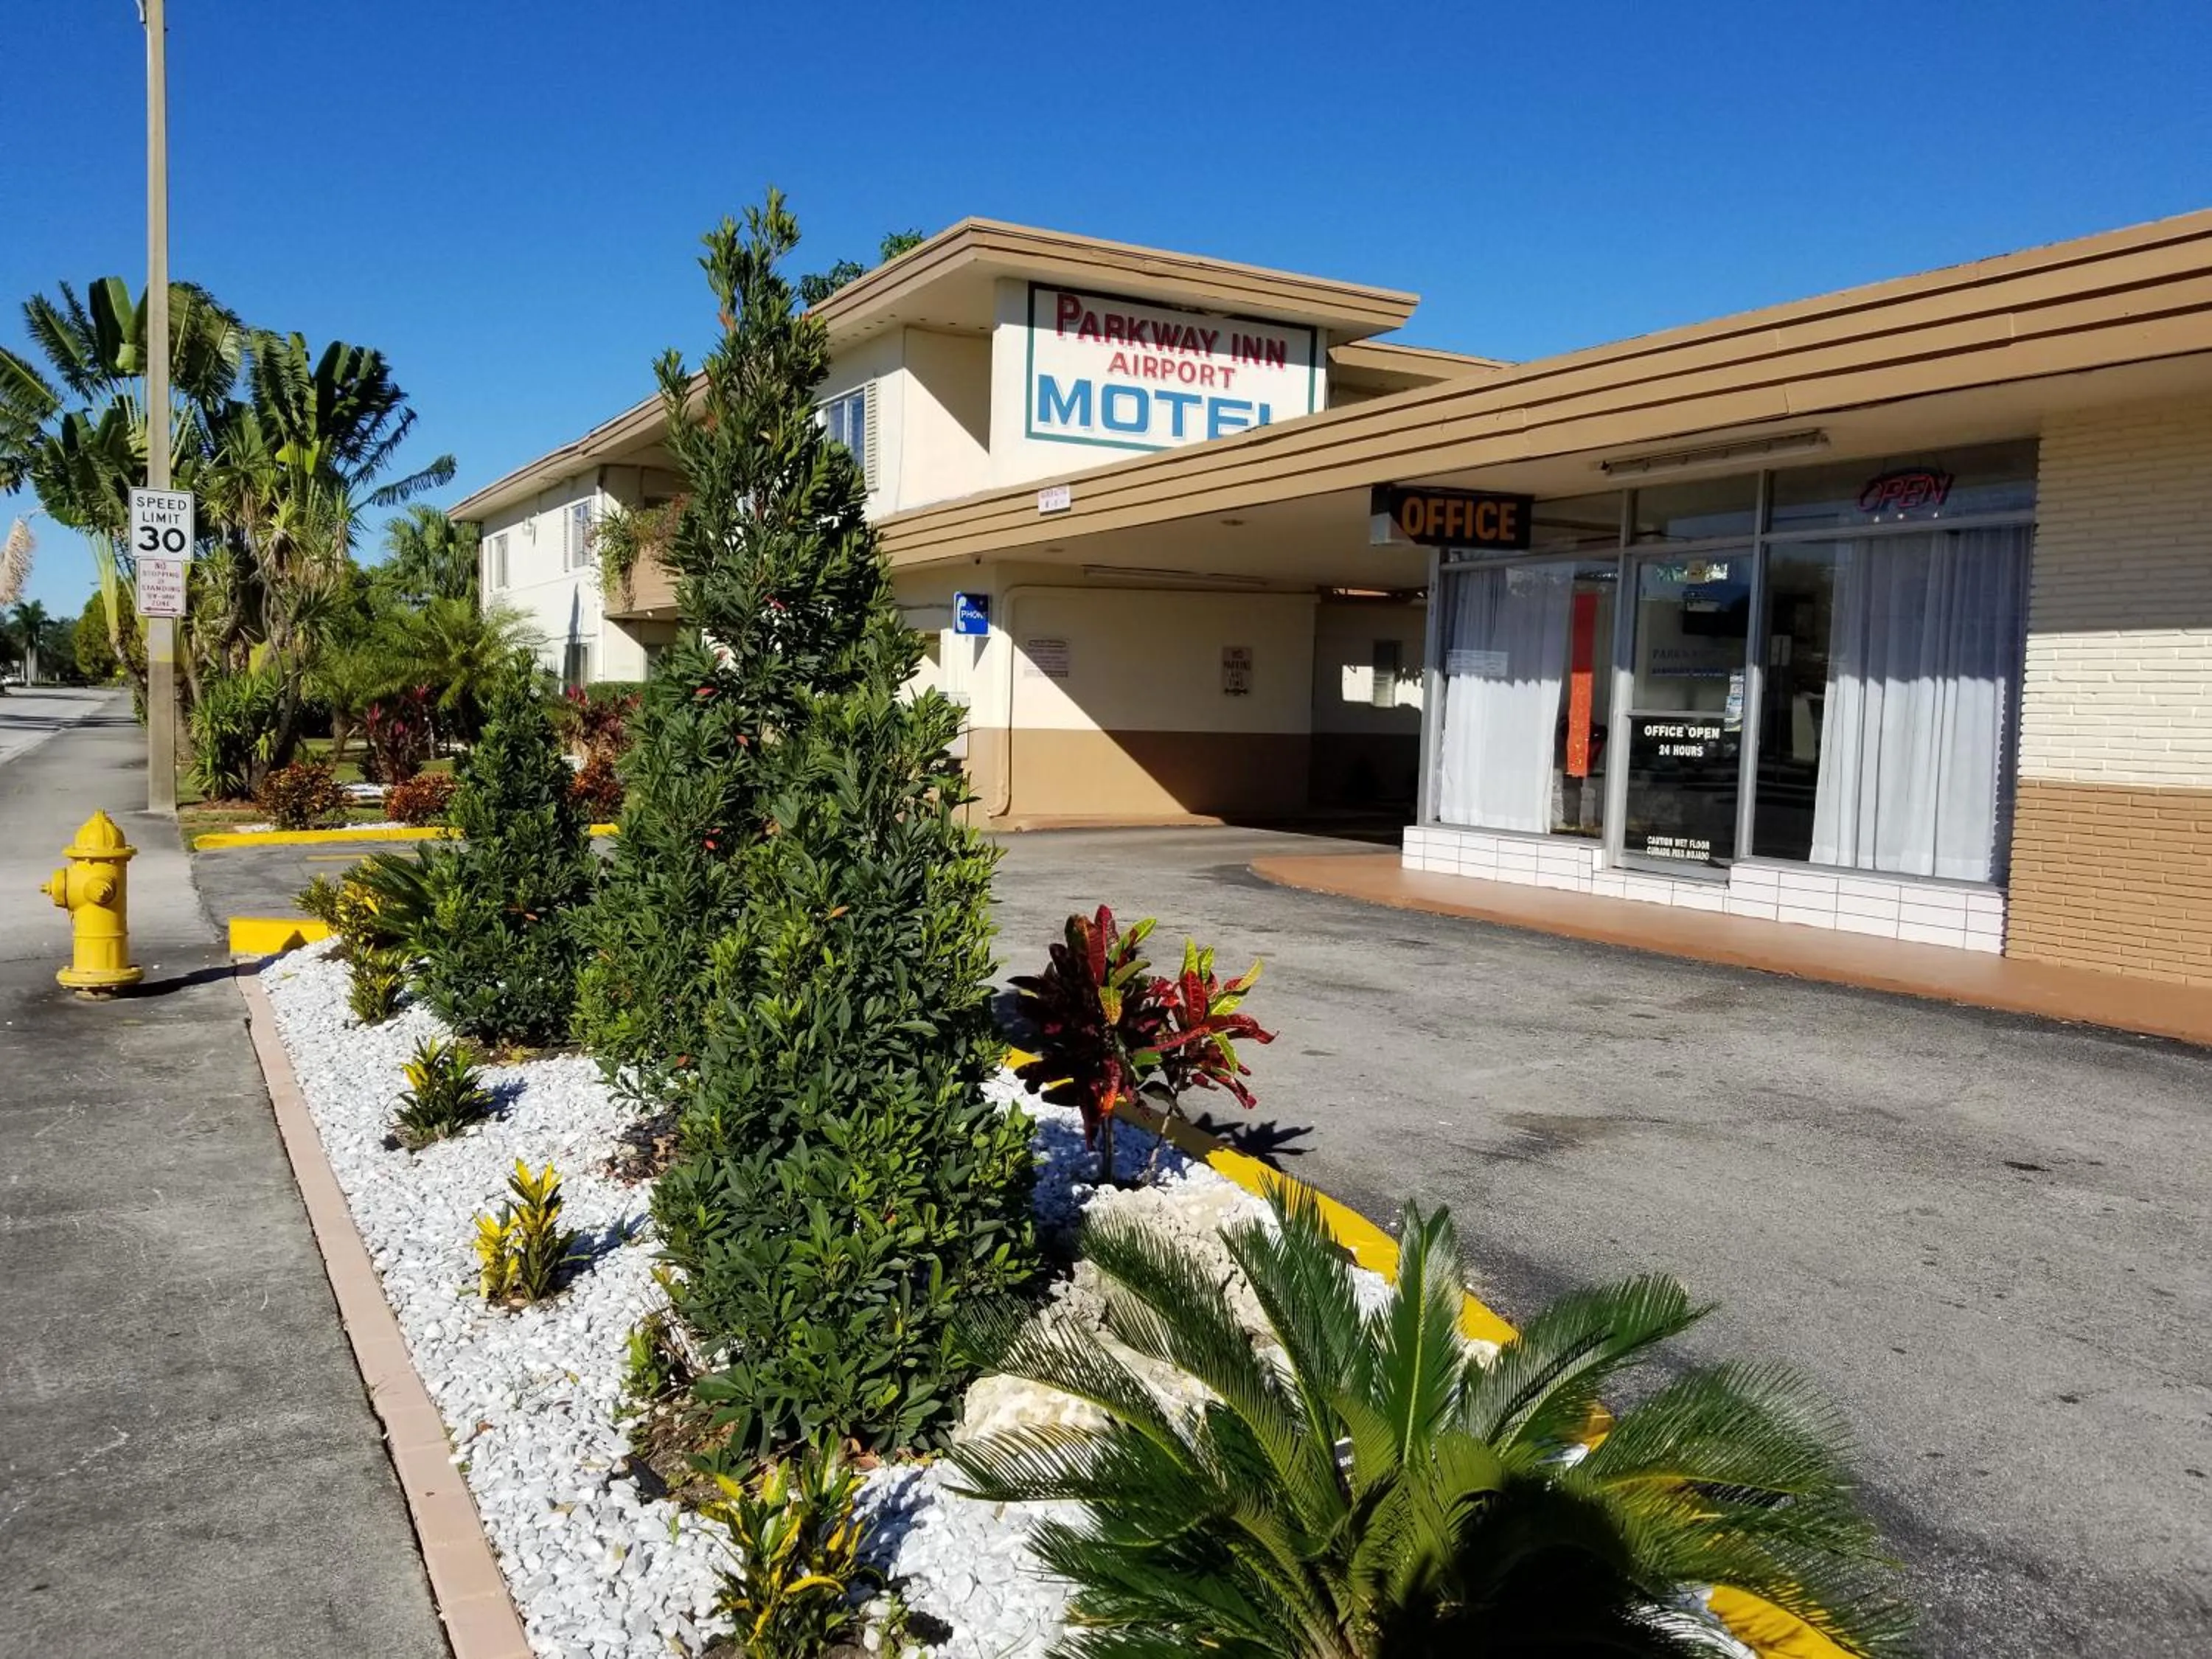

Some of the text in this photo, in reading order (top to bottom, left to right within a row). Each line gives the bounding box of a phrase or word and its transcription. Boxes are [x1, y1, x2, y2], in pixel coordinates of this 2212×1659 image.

[1057, 294, 1287, 369] PARKWAY INN
[1107, 352, 1237, 389] AIRPORT
[1857, 473, 1954, 512] OPEN
[136, 496, 187, 511] SPEED
[142, 511, 181, 524] LIMIT
[1402, 496, 1518, 541] OFFICE
[138, 526, 186, 553] 30
[155, 562, 166, 570] NO
[142, 570, 180, 578] STOPPING
[1644, 725, 1720, 740] OFFICE OPEN
[1658, 744, 1704, 757] 24 HOURS
[1674, 838, 1688, 848] WET
[1689, 839, 1710, 850] FLOOR
